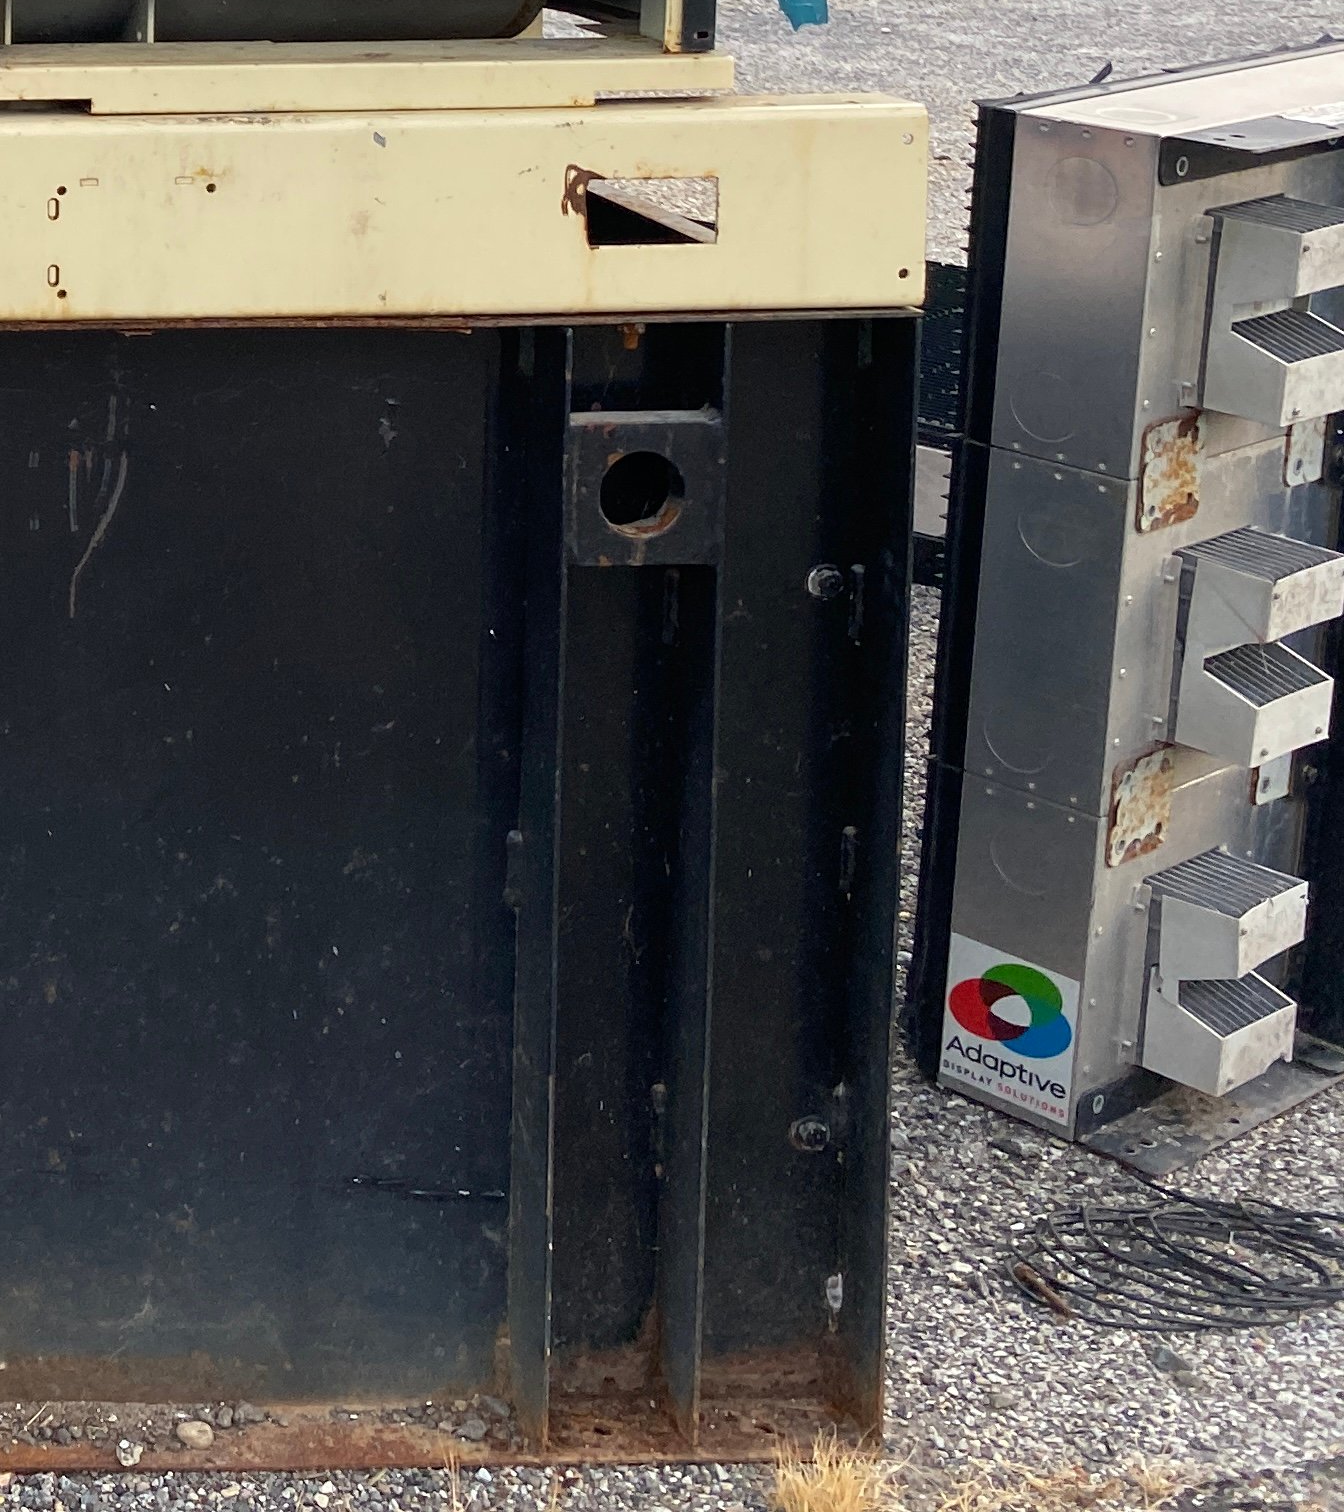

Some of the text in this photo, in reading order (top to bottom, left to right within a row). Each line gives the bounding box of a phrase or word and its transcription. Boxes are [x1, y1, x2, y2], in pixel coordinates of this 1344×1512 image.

[942, 1059, 1065, 1119] DISPLAY SOLUTIONS
[945, 1035, 1066, 1099] Adaptive
